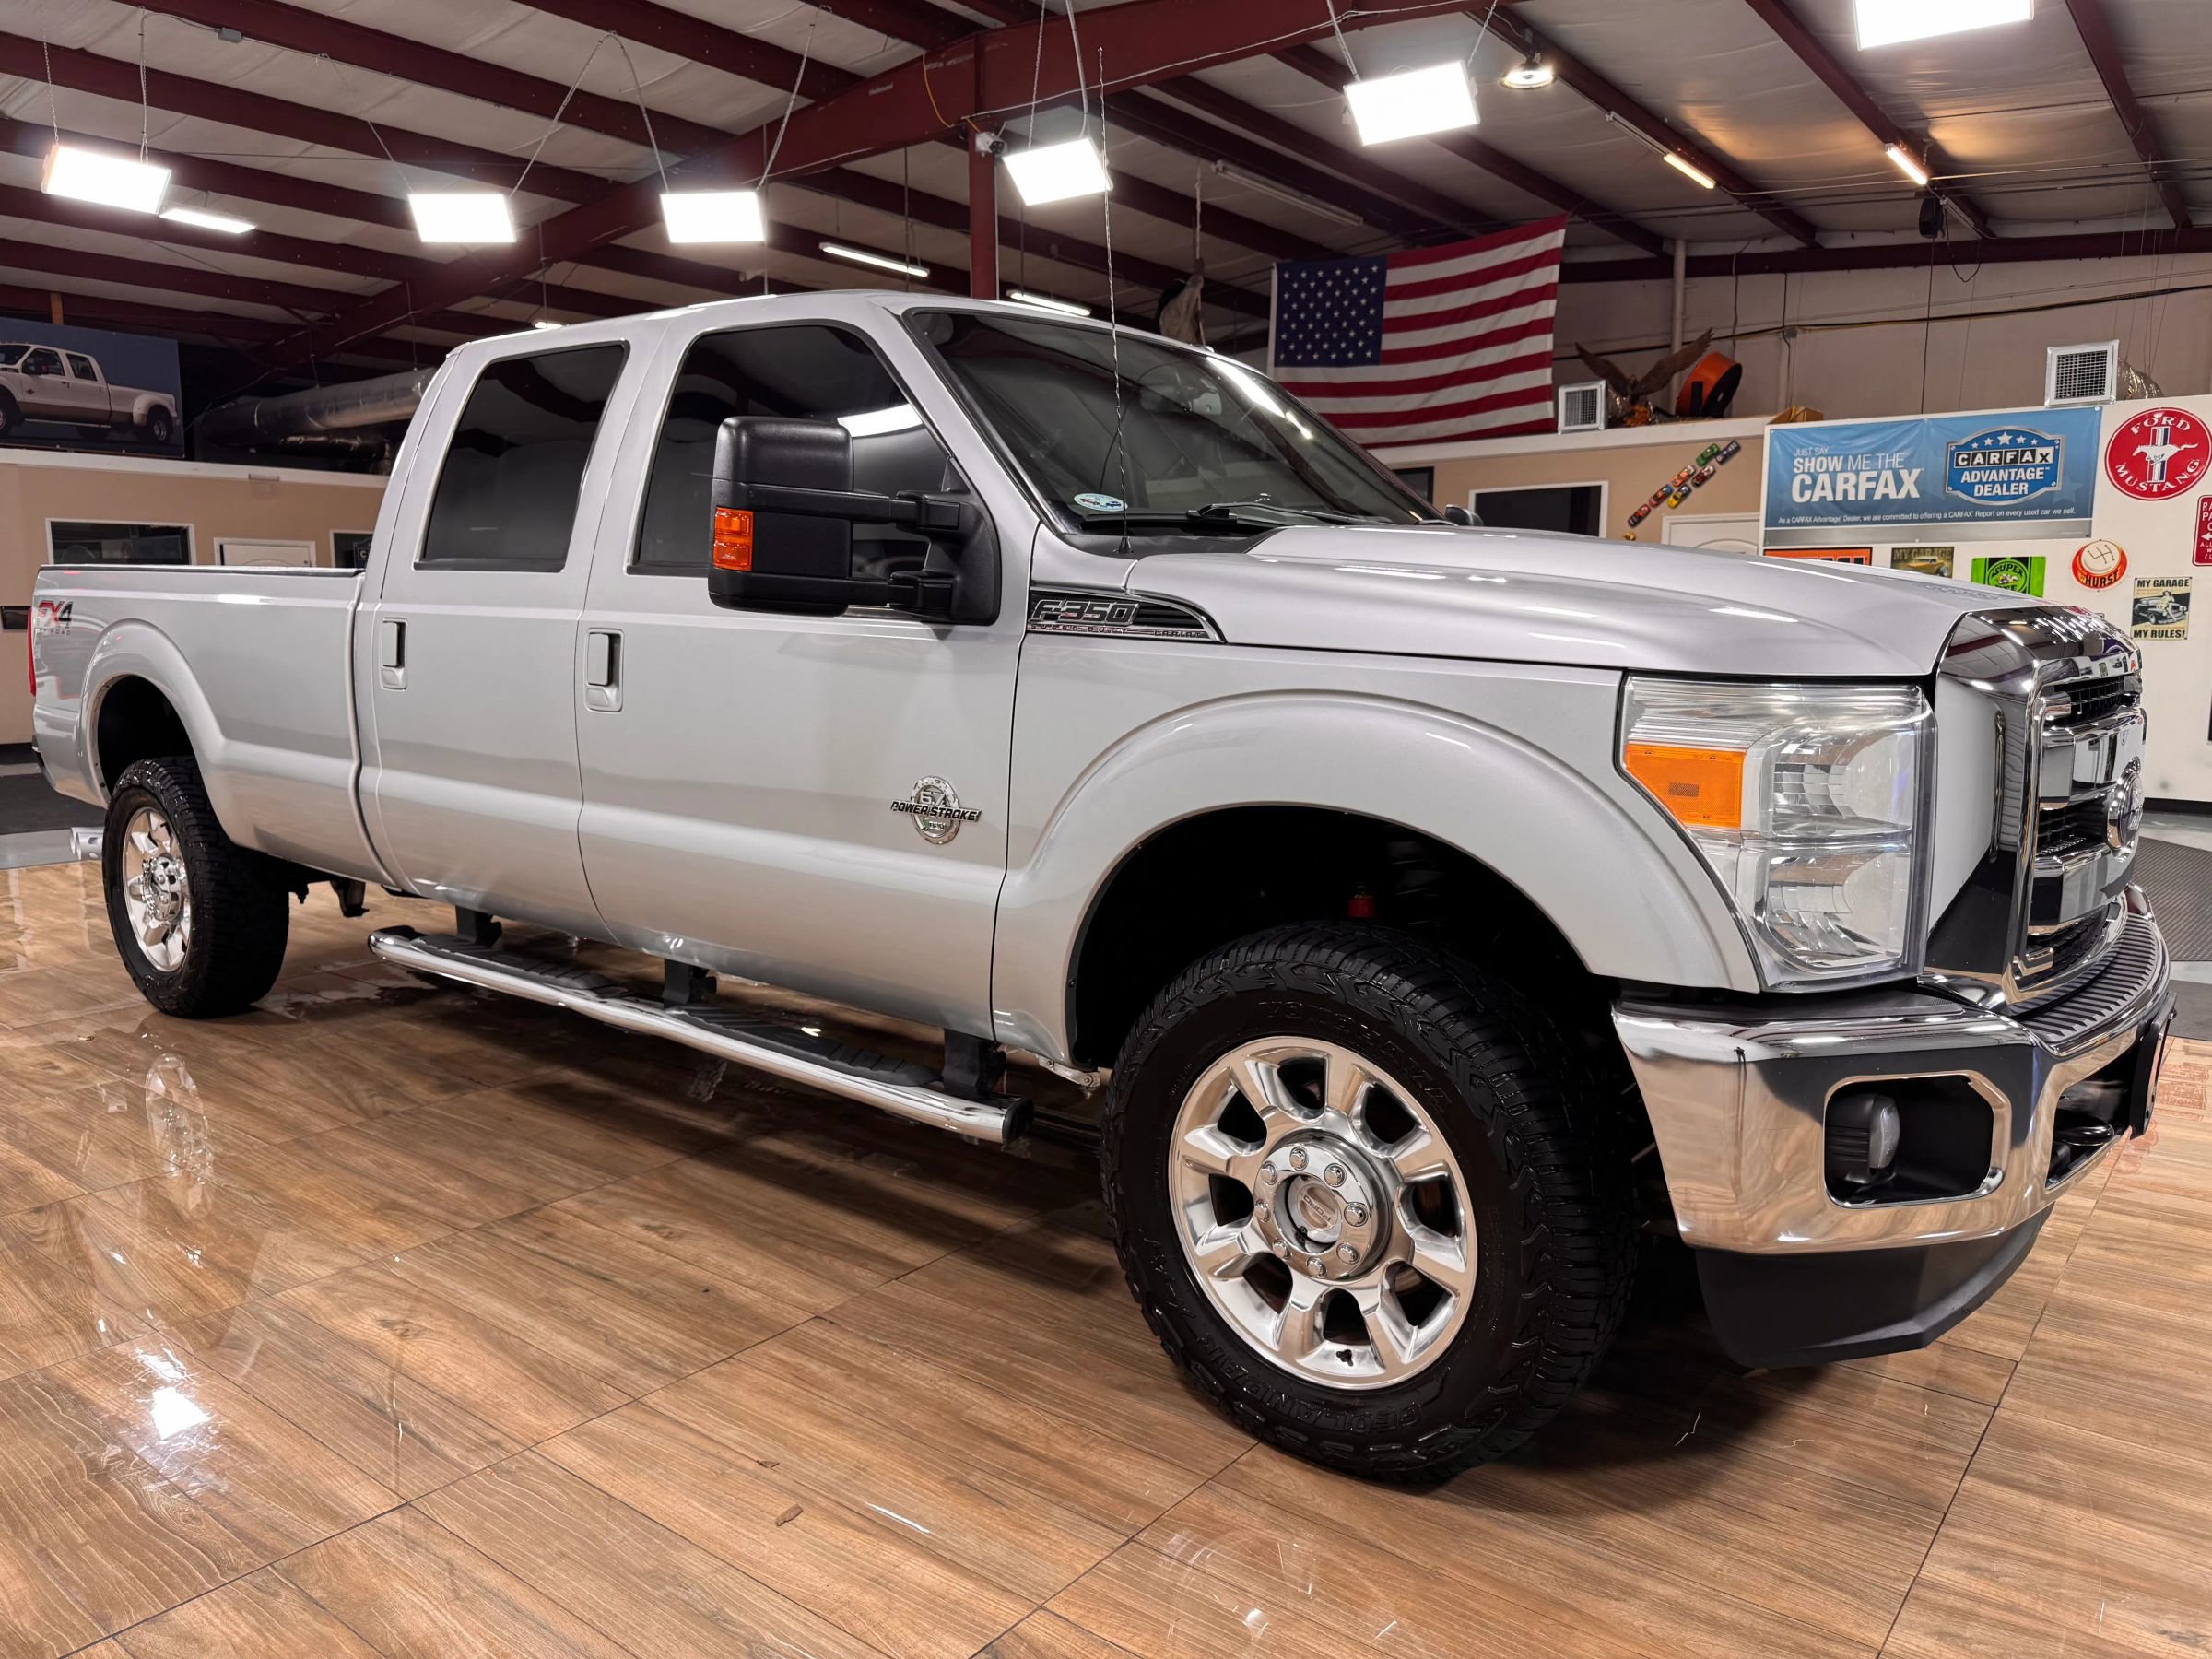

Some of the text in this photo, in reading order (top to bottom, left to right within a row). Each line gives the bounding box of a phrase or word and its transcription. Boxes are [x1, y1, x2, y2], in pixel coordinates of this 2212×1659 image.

[2129, 416, 2192, 436] FORD
[1794, 446, 1830, 457] JUST SAY
[1956, 449, 2052, 466] CARFAX
[1793, 452, 1906, 474] SHOW ME THE
[1960, 467, 2045, 484] ADVANTAGE
[2115, 458, 2201, 493] MUSTANG
[1791, 467, 1921, 504] CARFAX
[1973, 482, 2029, 498] DEALER
[1778, 516, 1785, 524] As
[1813, 515, 1841, 524] Advantage
[1882, 512, 1912, 521] committed
[1920, 512, 1942, 521] offering
[1975, 510, 1995, 518] Report
[2006, 510, 2022, 518] every
[2023, 508, 2039, 516] used
[2063, 506, 2076, 514] sell.
[1992, 563, 2023, 578] SUPER
[2085, 569, 2119, 587] HURST
[2136, 578, 2190, 588] MY GARAGE
[38, 599, 74, 626] FX4
[2133, 629, 2185, 639] MY RULES!
[890, 800, 929, 816] POWER
[1303, 1194, 1332, 1222] FORD
